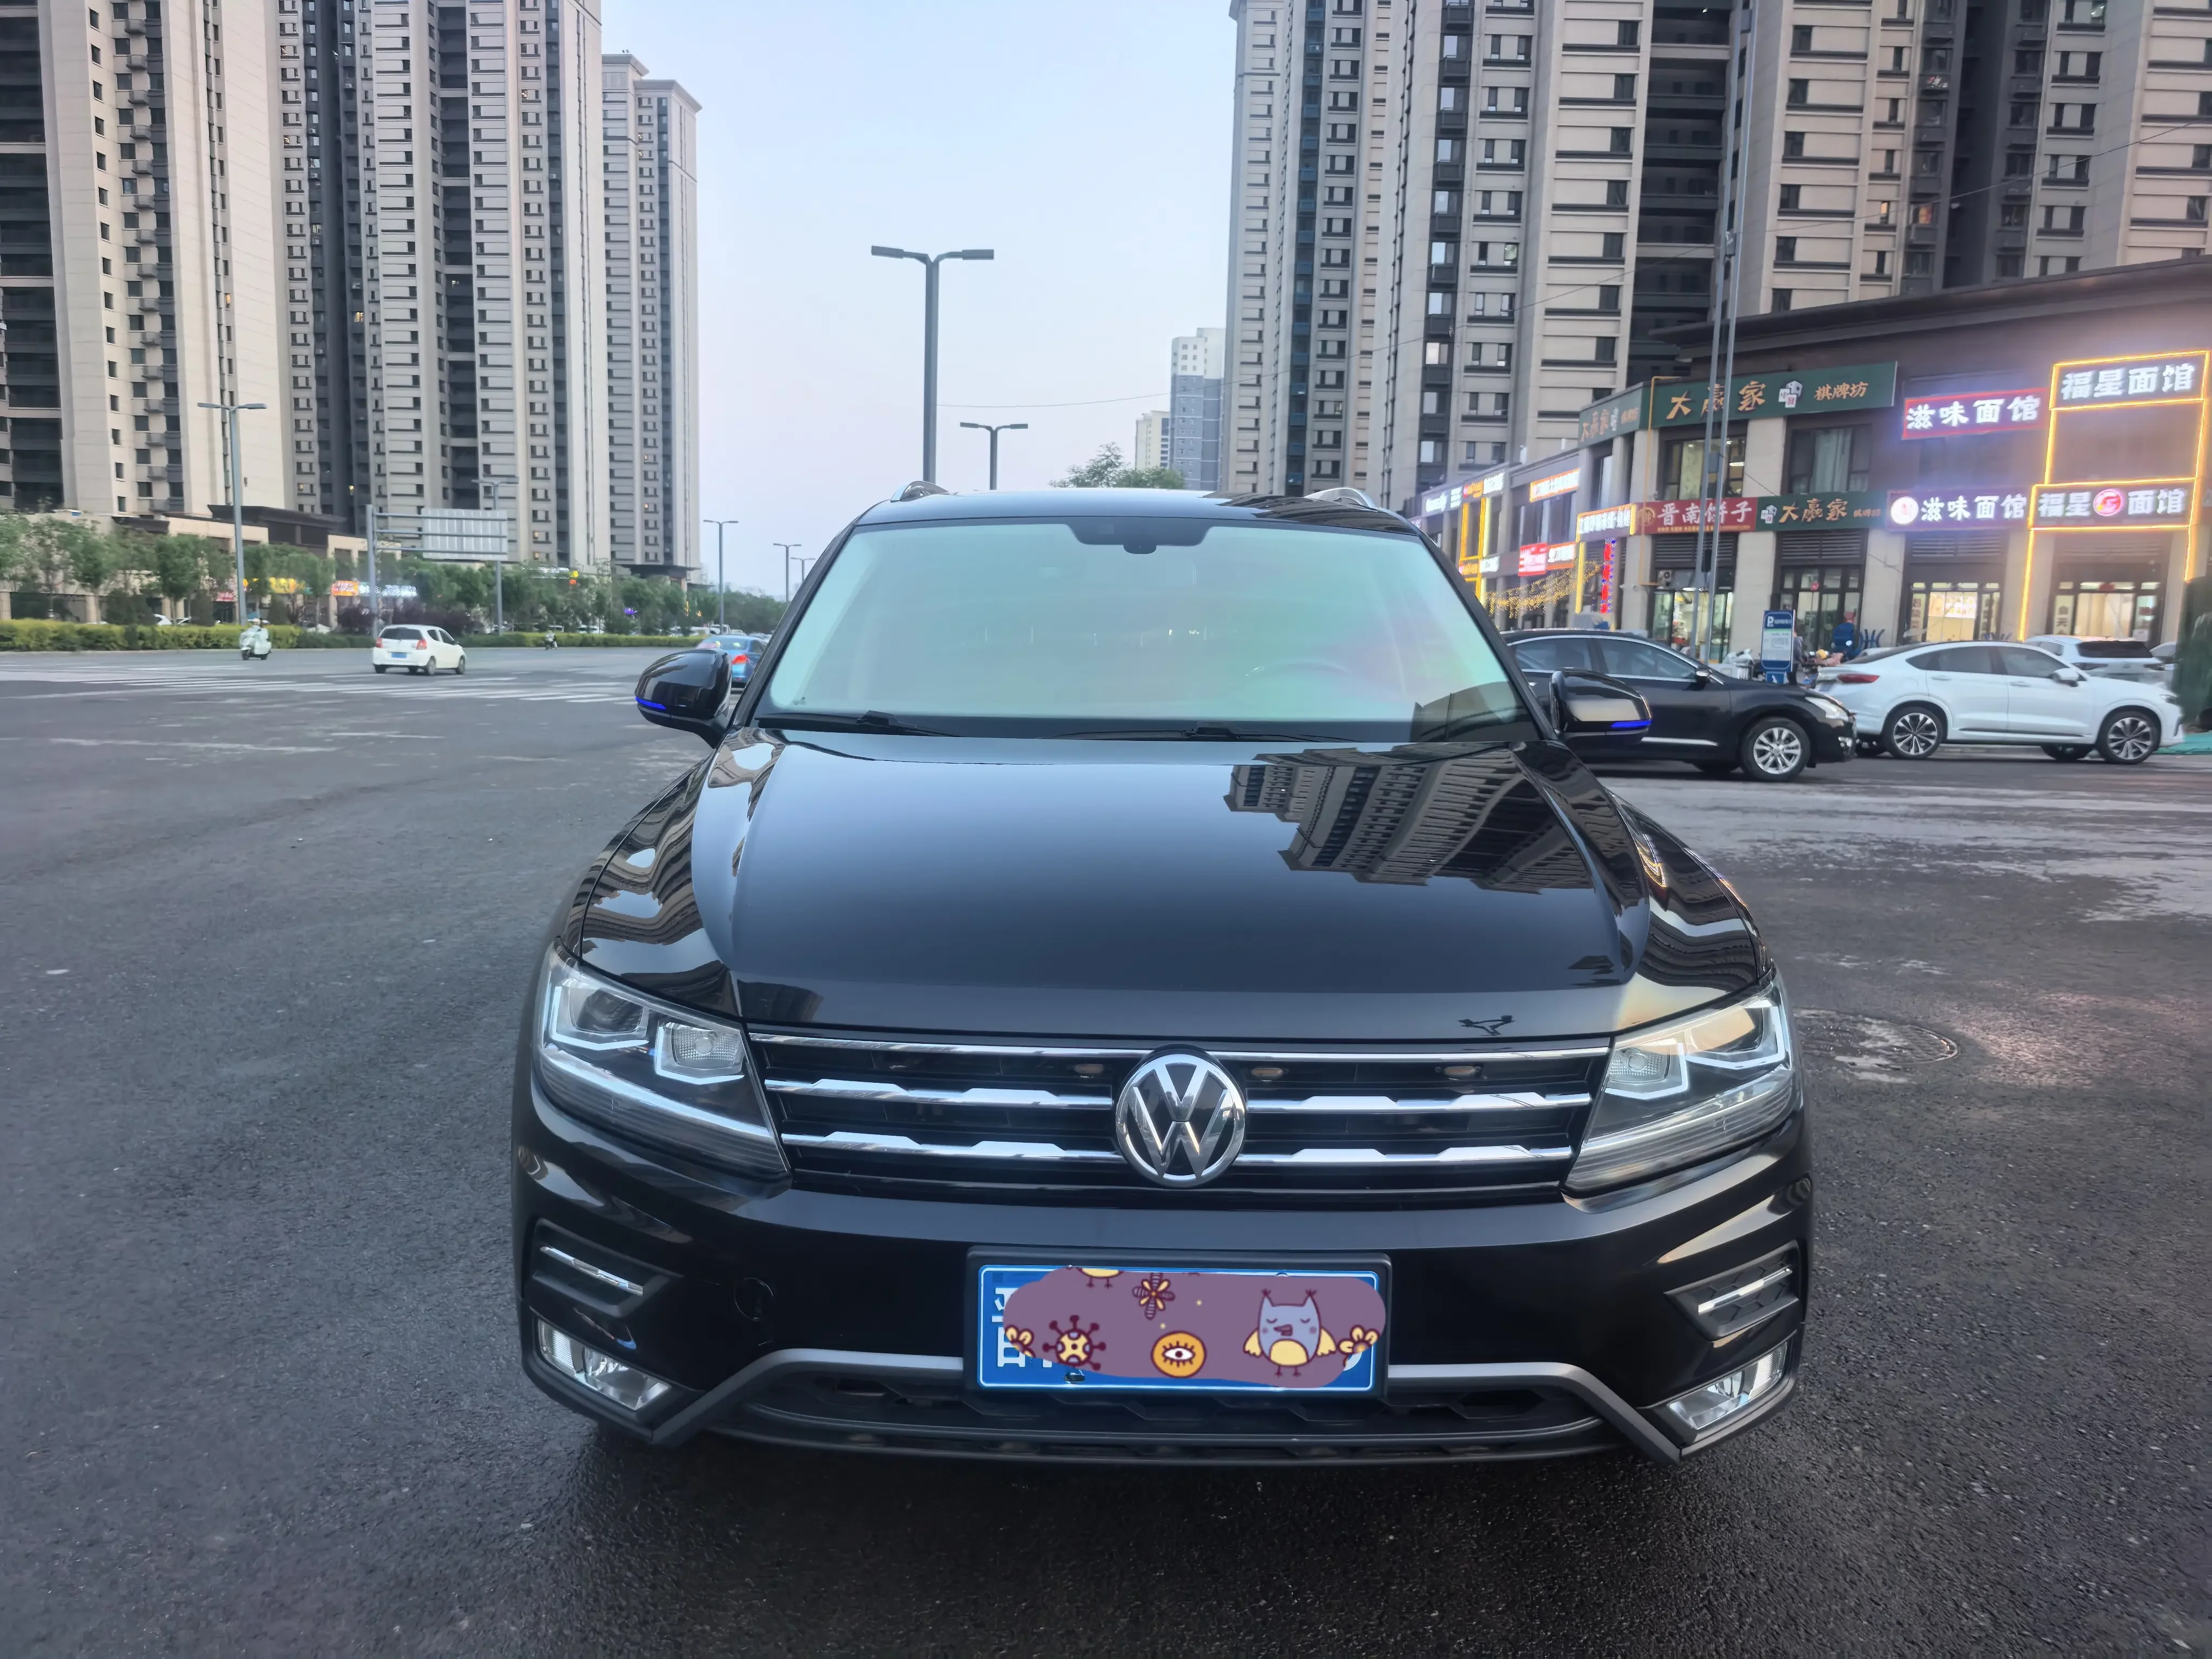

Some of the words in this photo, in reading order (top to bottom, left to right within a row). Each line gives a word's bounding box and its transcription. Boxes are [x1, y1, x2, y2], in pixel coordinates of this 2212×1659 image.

[1813, 381, 1869, 401] 棋牌坊
[2060, 363, 2195, 400] 福星面馆
[1906, 395, 2041, 430] 滋味面馆
[1657, 501, 1753, 526] 晋南饼子
[1778, 497, 1849, 523] 大赢家
[1920, 493, 2027, 522] 滋味面馆
[2038, 491, 2091, 517] 福星
[2127, 488, 2186, 515] 面馆
